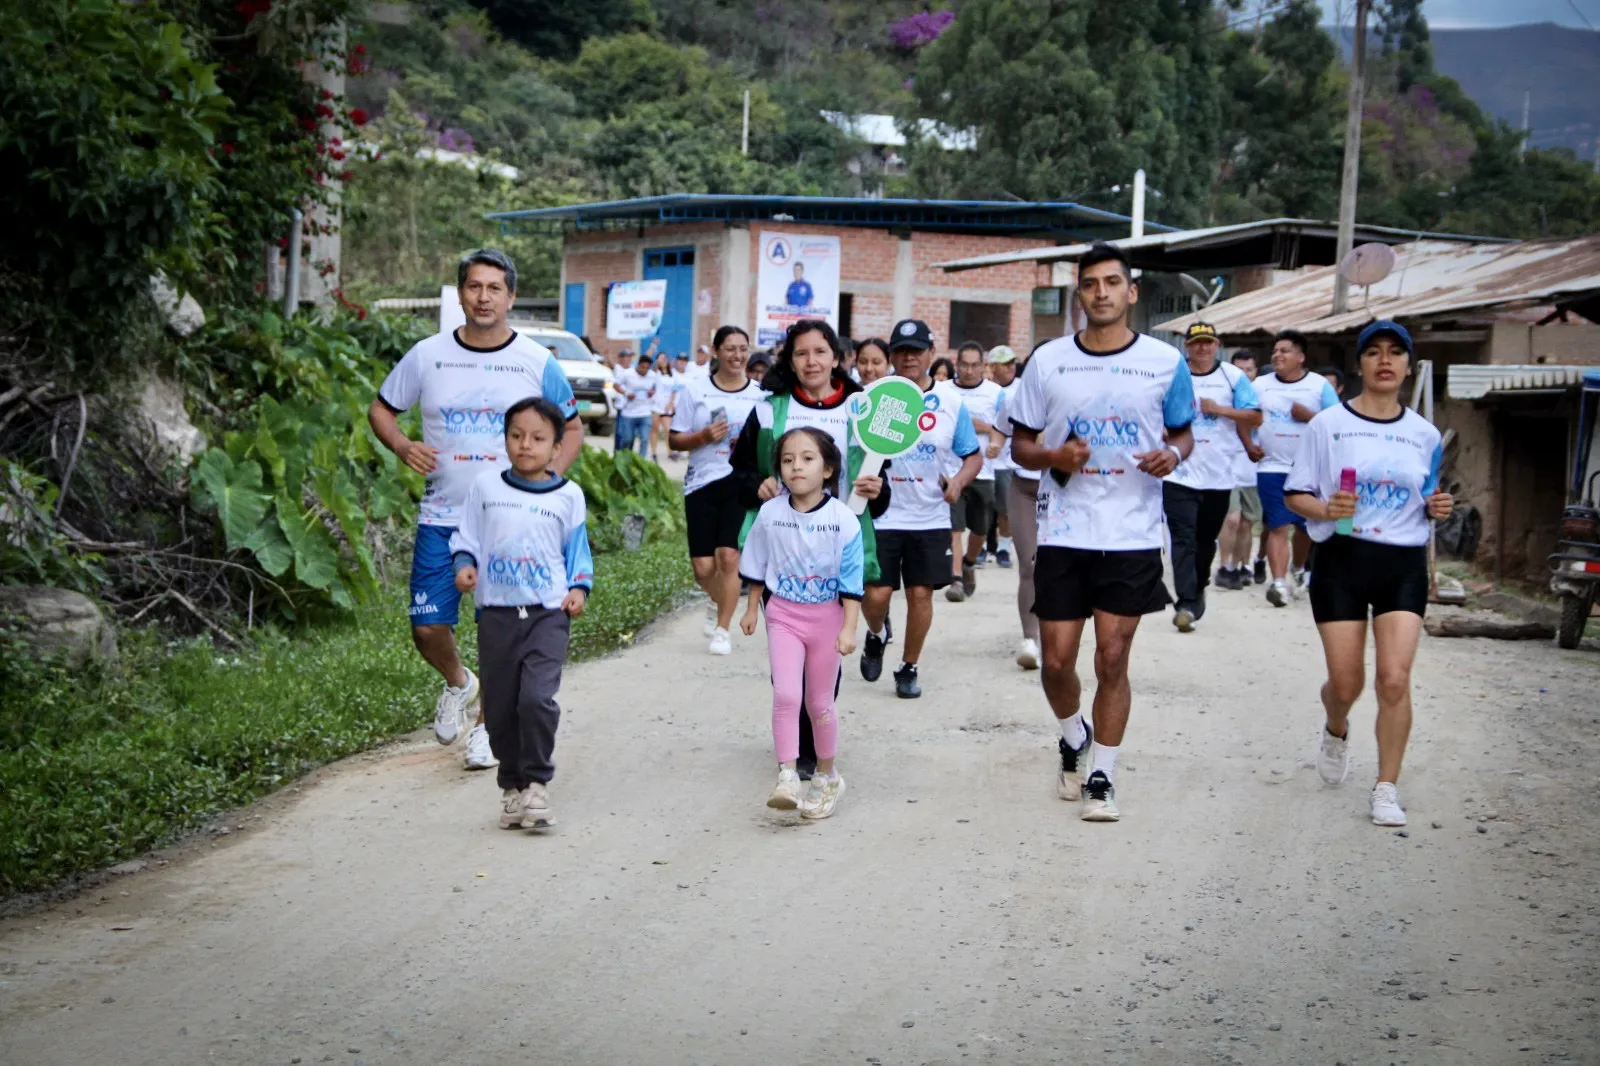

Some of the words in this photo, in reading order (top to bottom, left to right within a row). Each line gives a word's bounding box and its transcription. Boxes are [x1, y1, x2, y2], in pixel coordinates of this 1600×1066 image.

[772, 241, 786, 259] A
[494, 365, 525, 373] DEVIDA
[1122, 367, 1155, 379] DEVIDA
[876, 403, 911, 424] MODO
